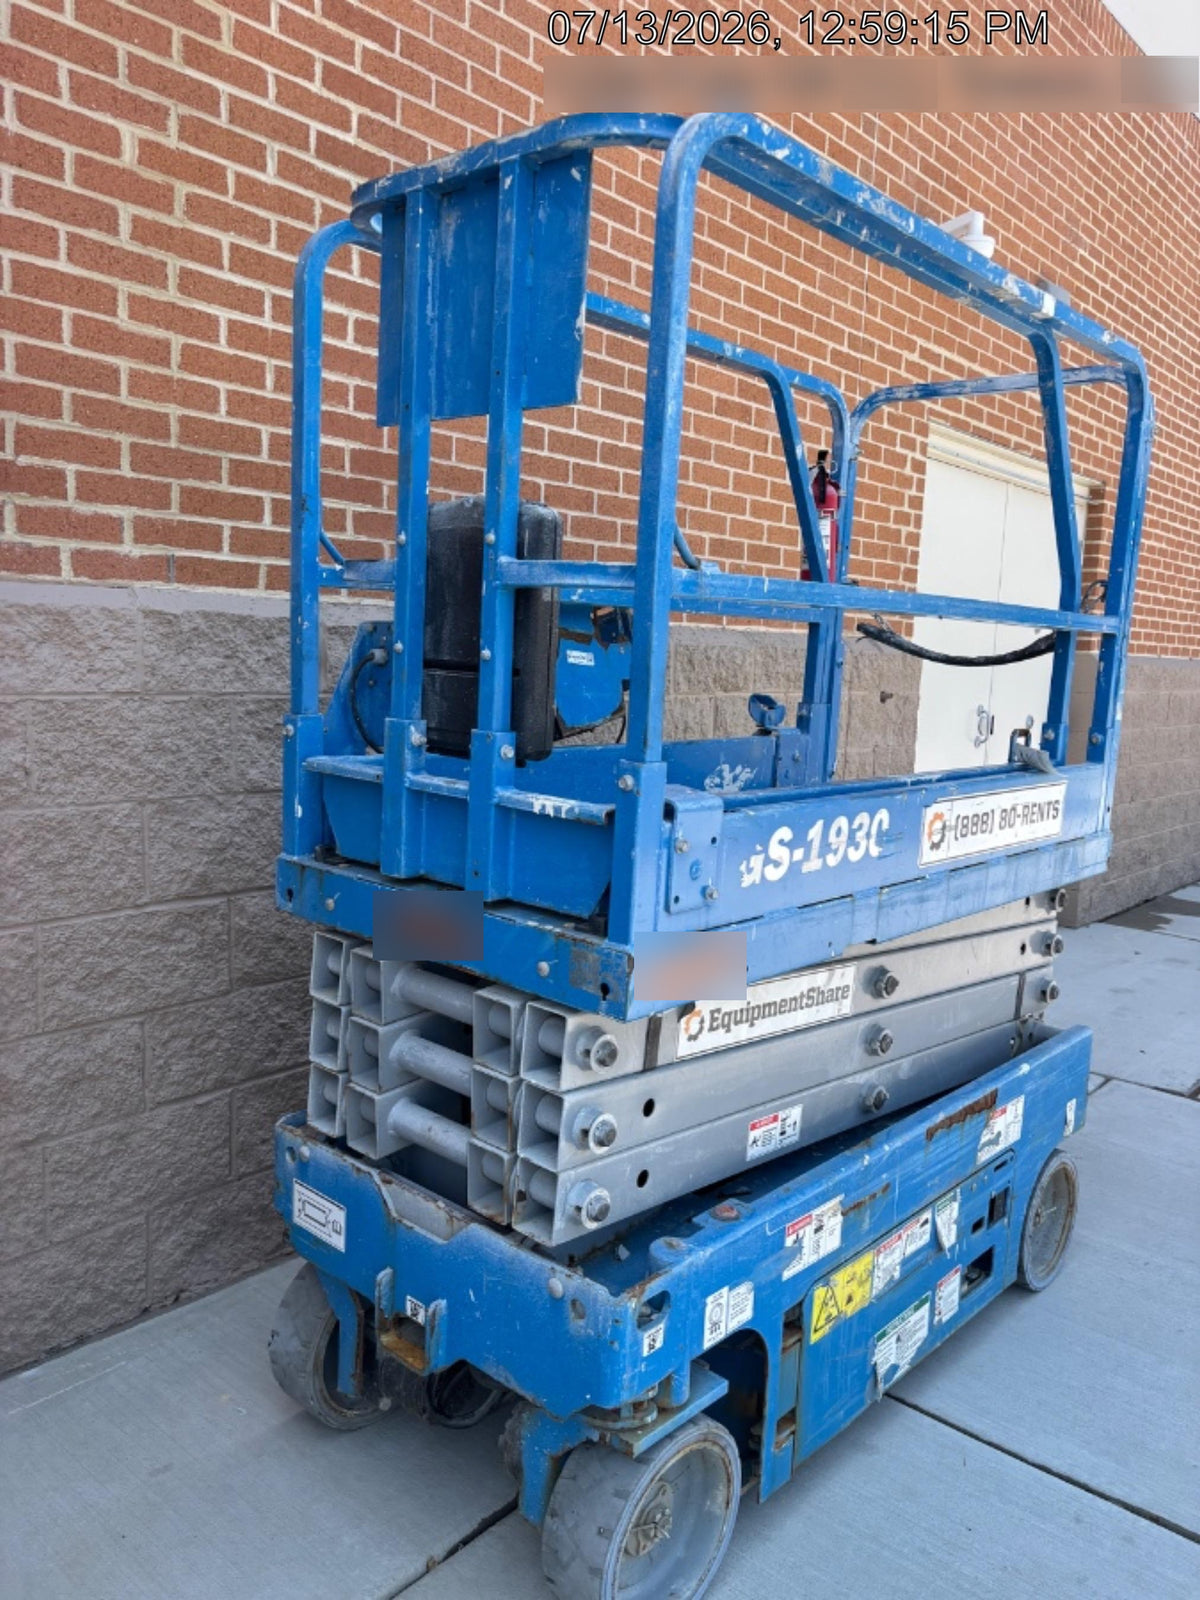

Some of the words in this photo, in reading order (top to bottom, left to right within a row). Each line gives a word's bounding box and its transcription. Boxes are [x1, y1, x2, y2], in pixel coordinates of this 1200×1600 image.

[953, 808, 995, 841] (888)
[998, 799, 1061, 831] 80-RENTS
[707, 983, 851, 1034] EquipmentShare
